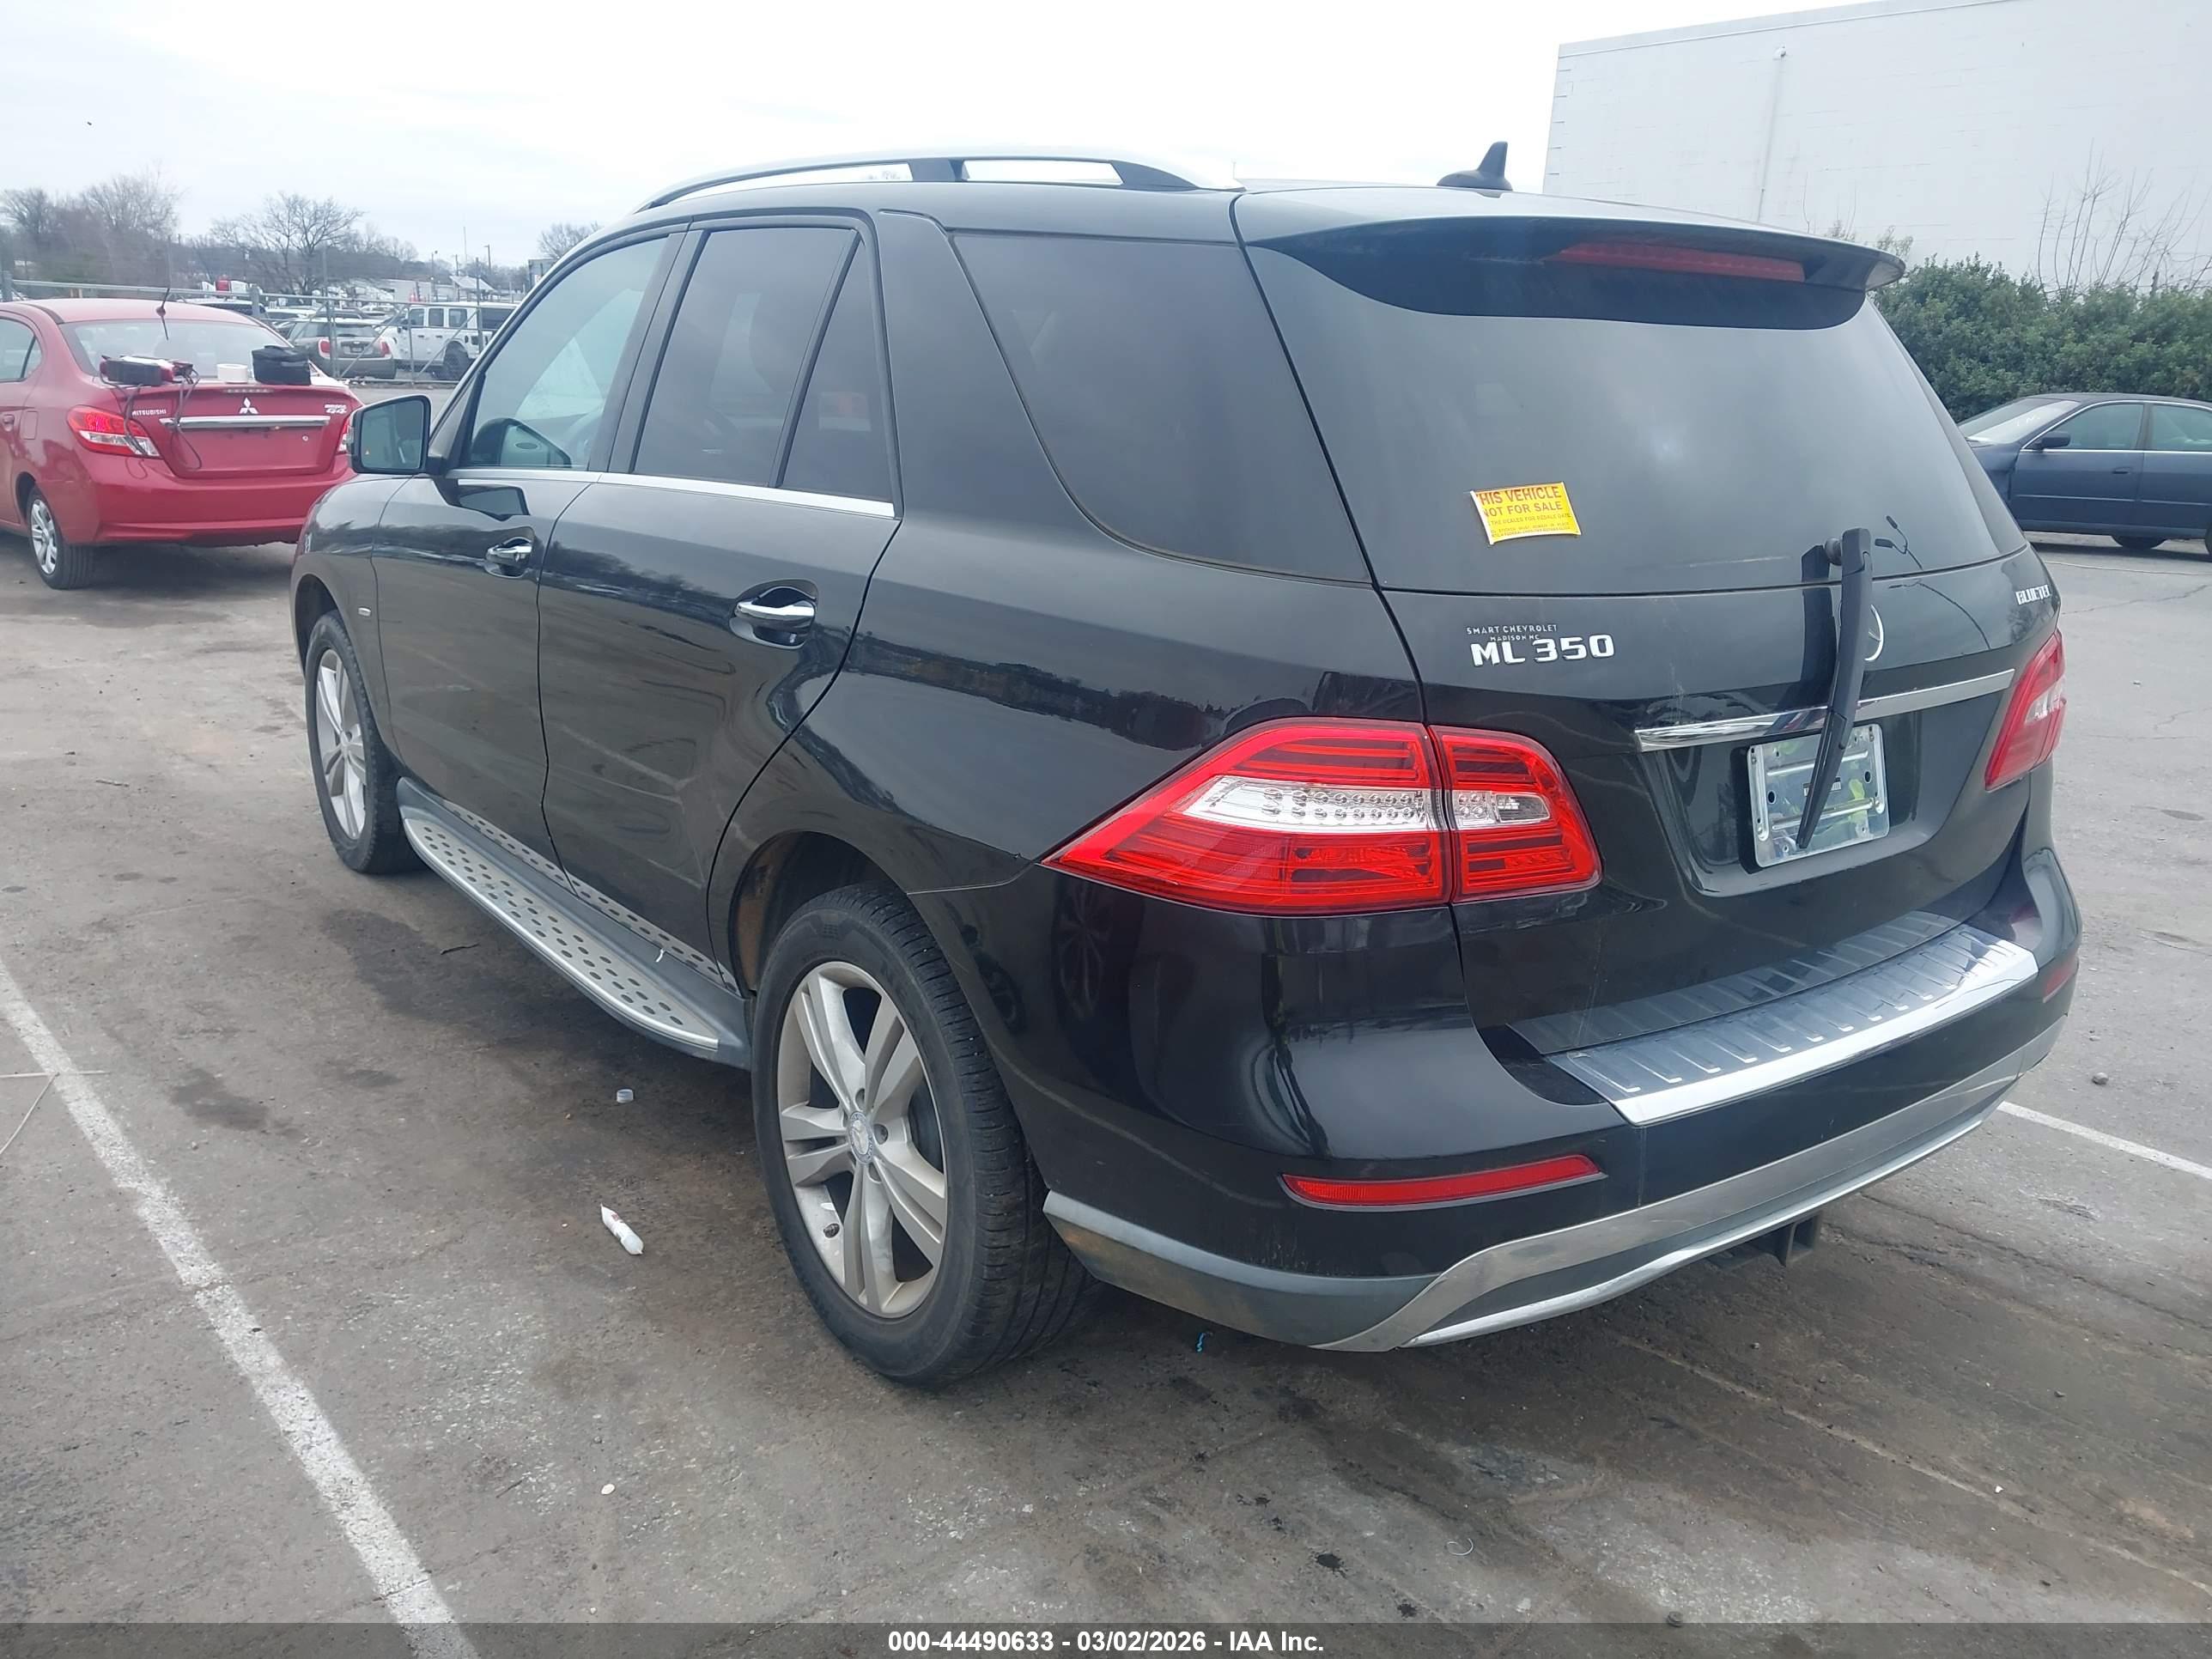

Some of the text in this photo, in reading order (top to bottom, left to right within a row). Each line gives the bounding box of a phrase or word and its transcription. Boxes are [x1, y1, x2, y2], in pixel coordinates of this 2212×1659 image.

[1504, 486, 1562, 502] VEHICLE
[1507, 505, 1531, 515] FOR
[1534, 501, 1563, 512] SALE
[1466, 624, 1558, 635] SMART CHEVROLET
[1470, 634, 1615, 667] ML 350
